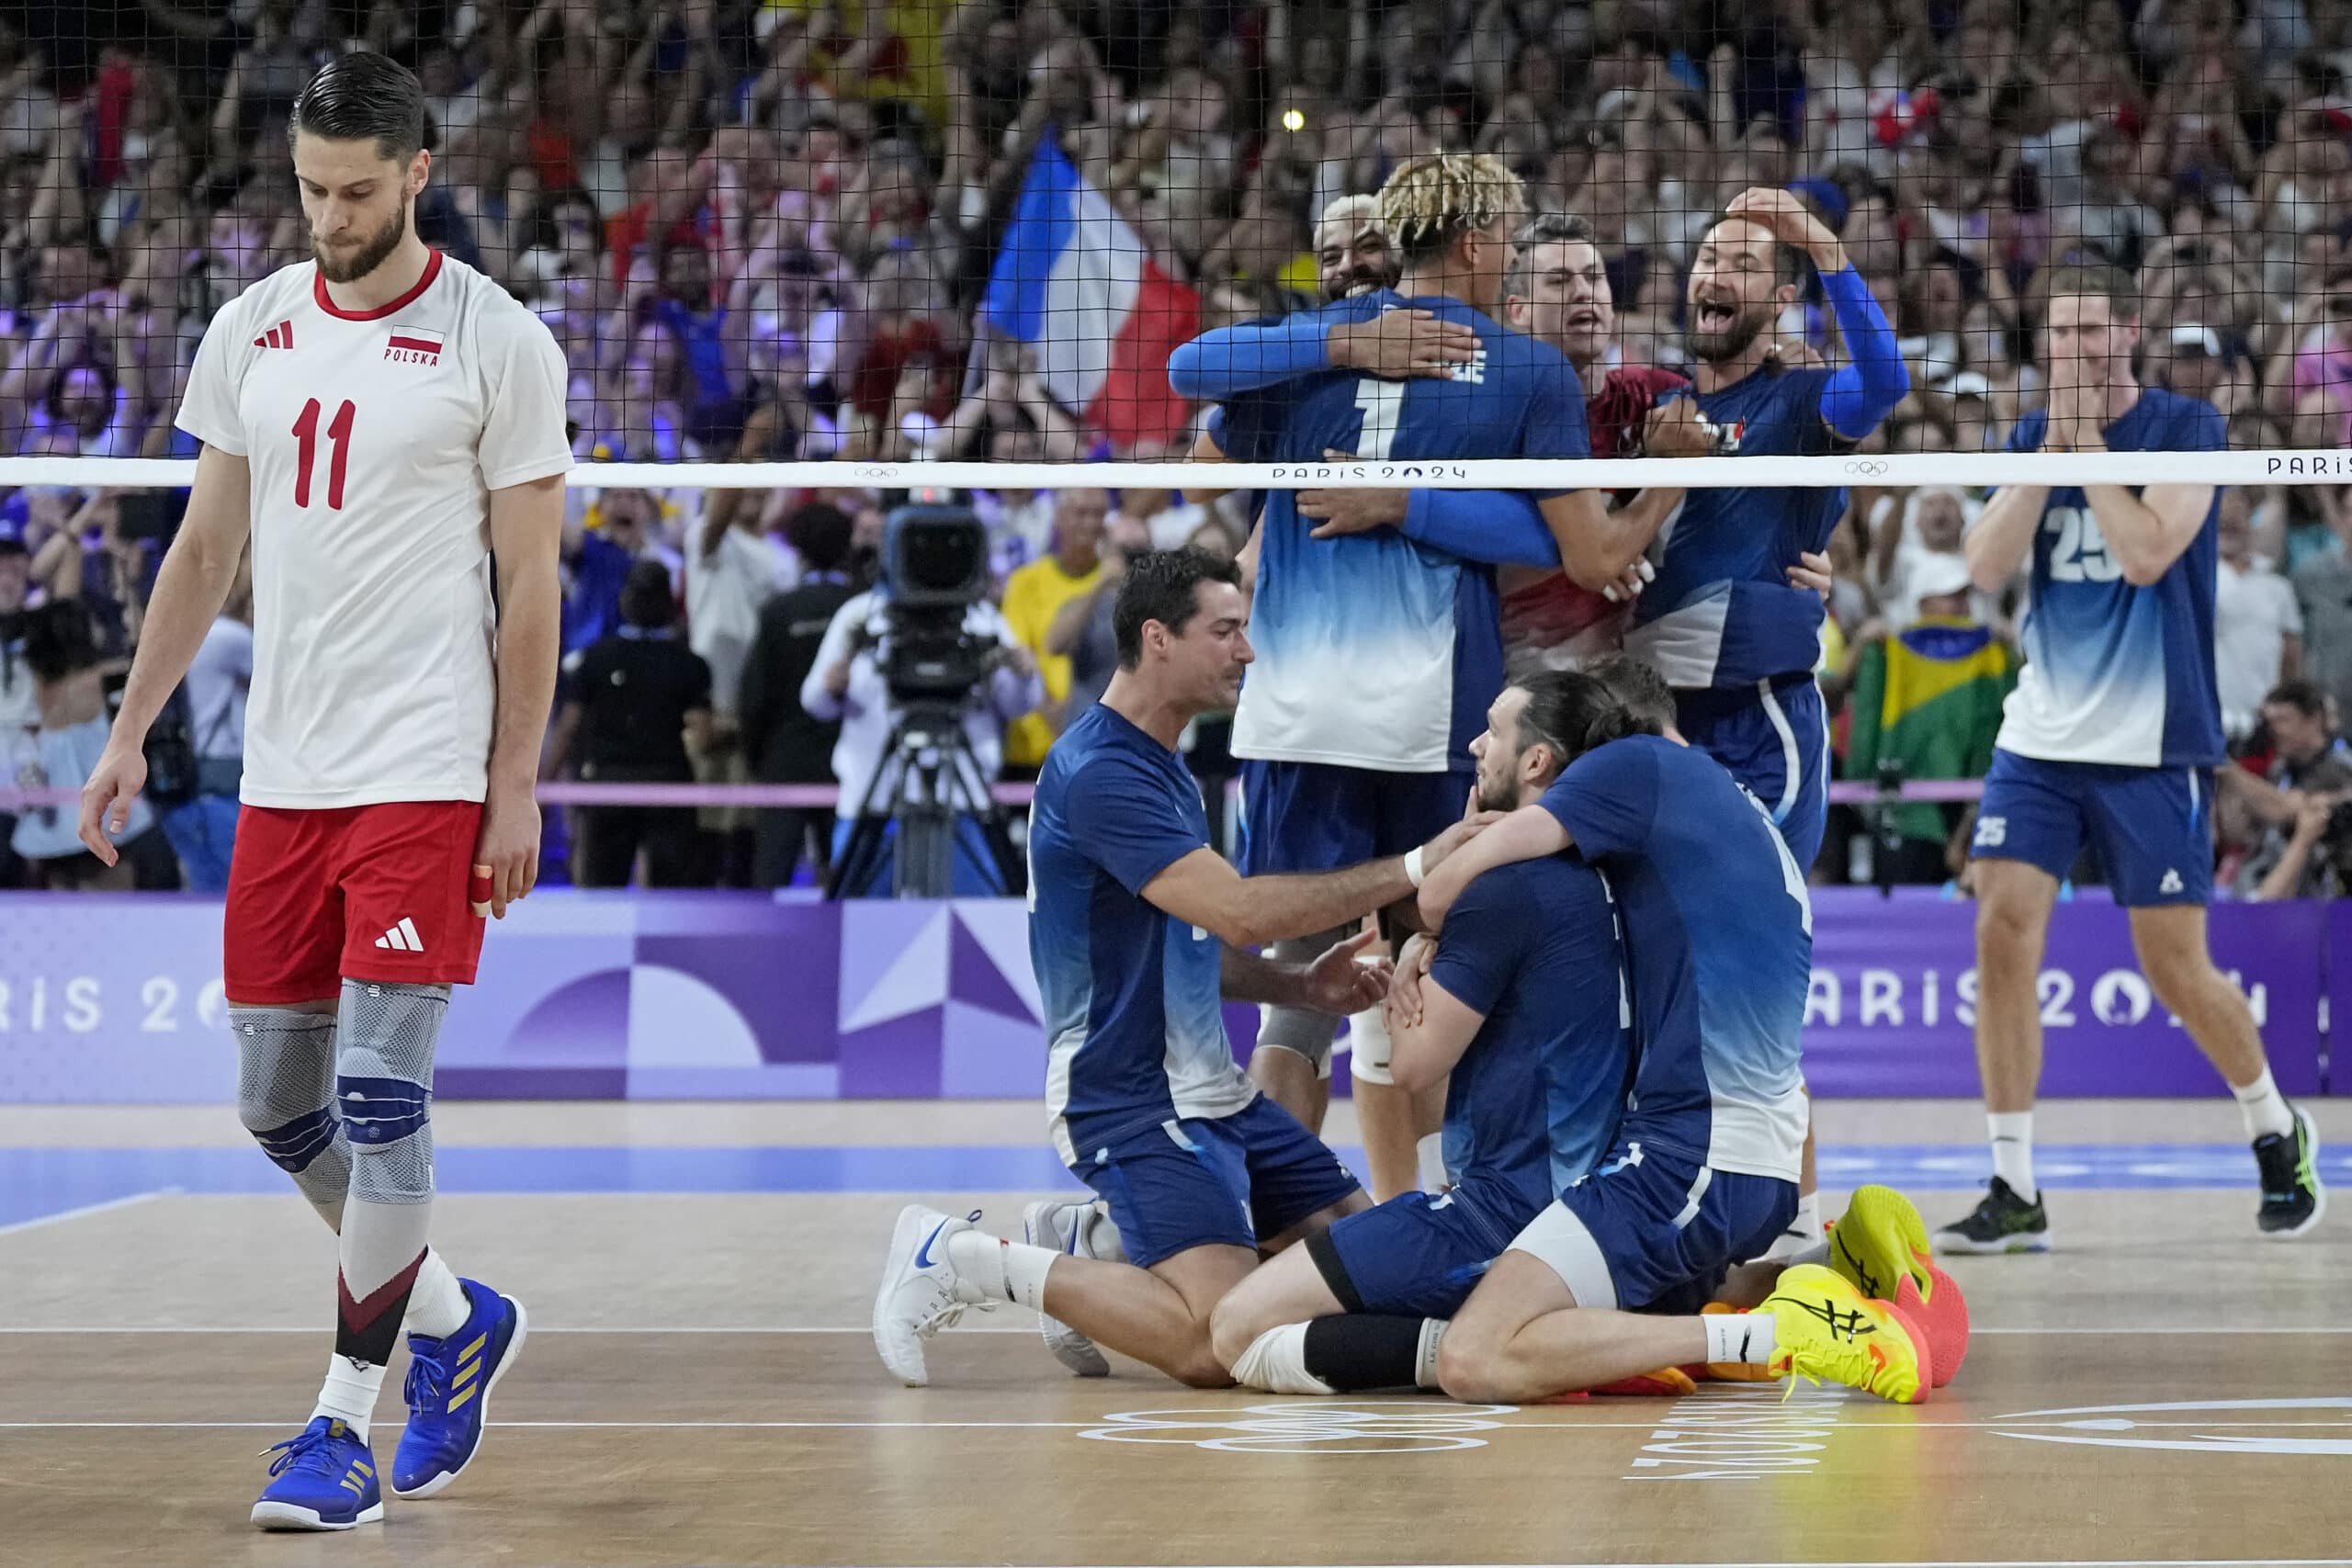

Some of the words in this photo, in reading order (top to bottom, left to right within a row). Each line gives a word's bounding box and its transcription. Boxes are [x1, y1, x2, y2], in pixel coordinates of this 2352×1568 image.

[383, 348, 438, 367] POLSKA
[1354, 378, 1406, 461] 1
[291, 397, 356, 511] 11
[2267, 456, 2352, 475] PARi
[1973, 815, 2007, 847] 25
